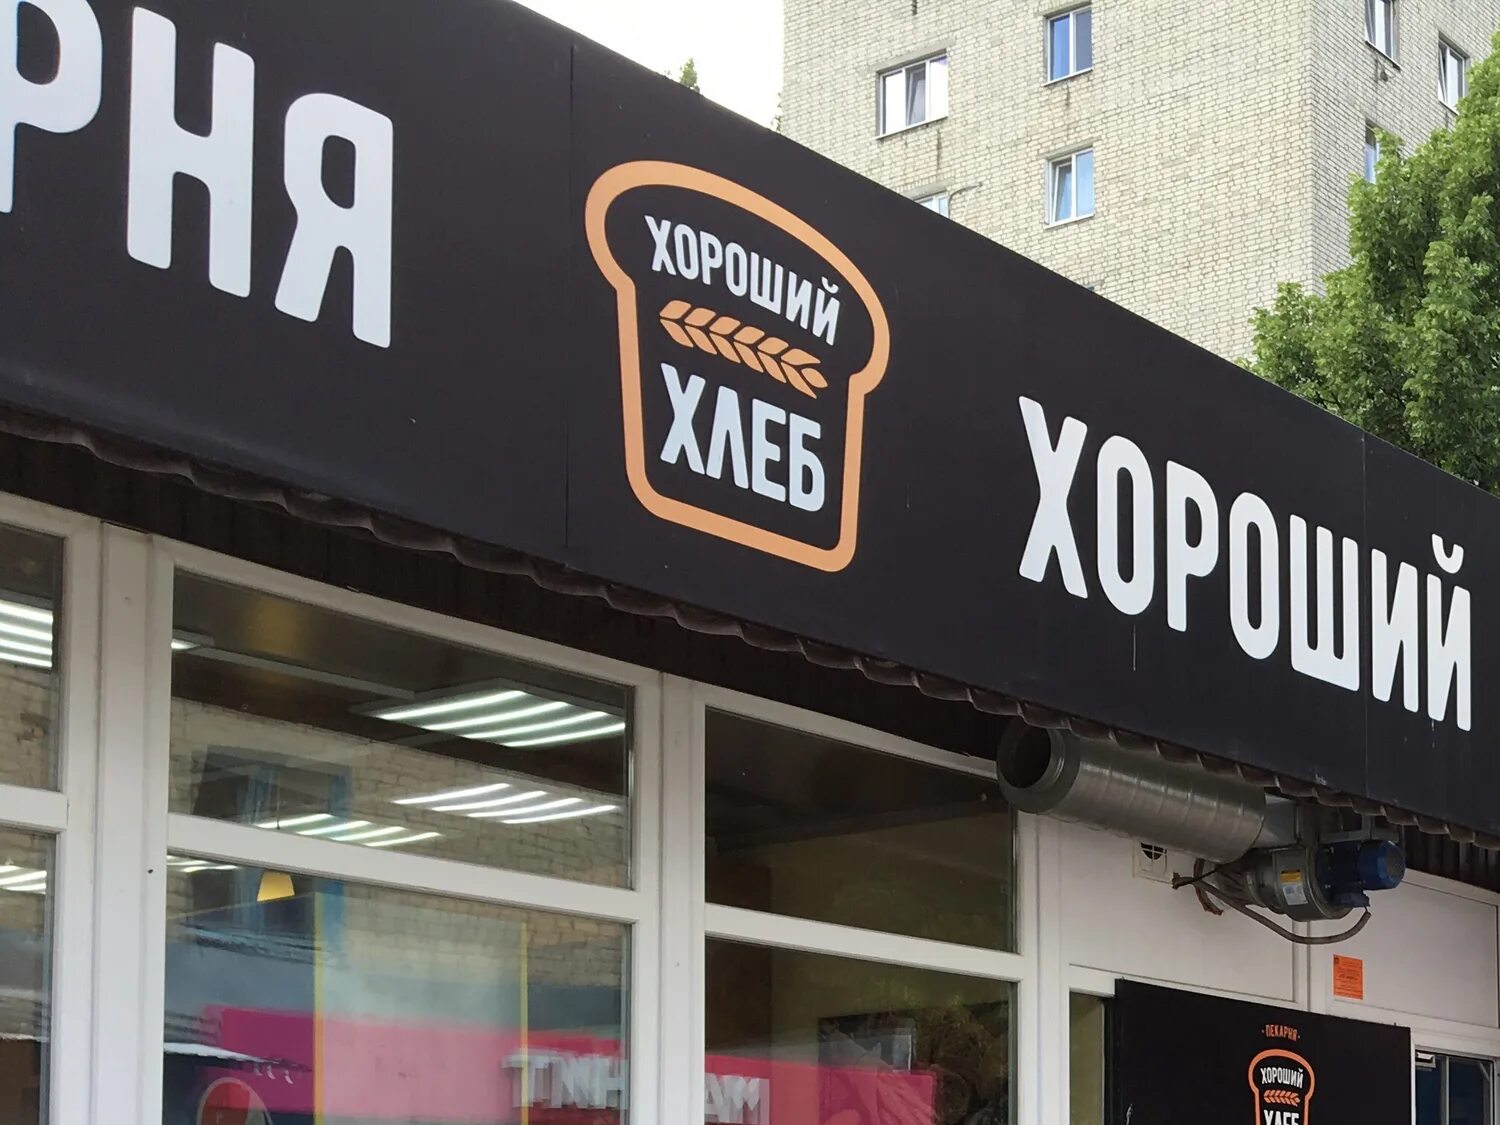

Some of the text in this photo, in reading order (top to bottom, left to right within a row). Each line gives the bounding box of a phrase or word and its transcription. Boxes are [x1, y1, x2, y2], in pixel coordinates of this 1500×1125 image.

[0, 0, 394, 349] РНЯ
[644, 215, 841, 347] ХОРОШИЙ
[660, 363, 825, 512] ХЛЕБ
[1018, 395, 1472, 732] ХОРОШИЙ
[1260, 1066, 1304, 1089] ХОРОШИЙ
[1265, 1024, 1298, 1041] ПЕКАРНЯ
